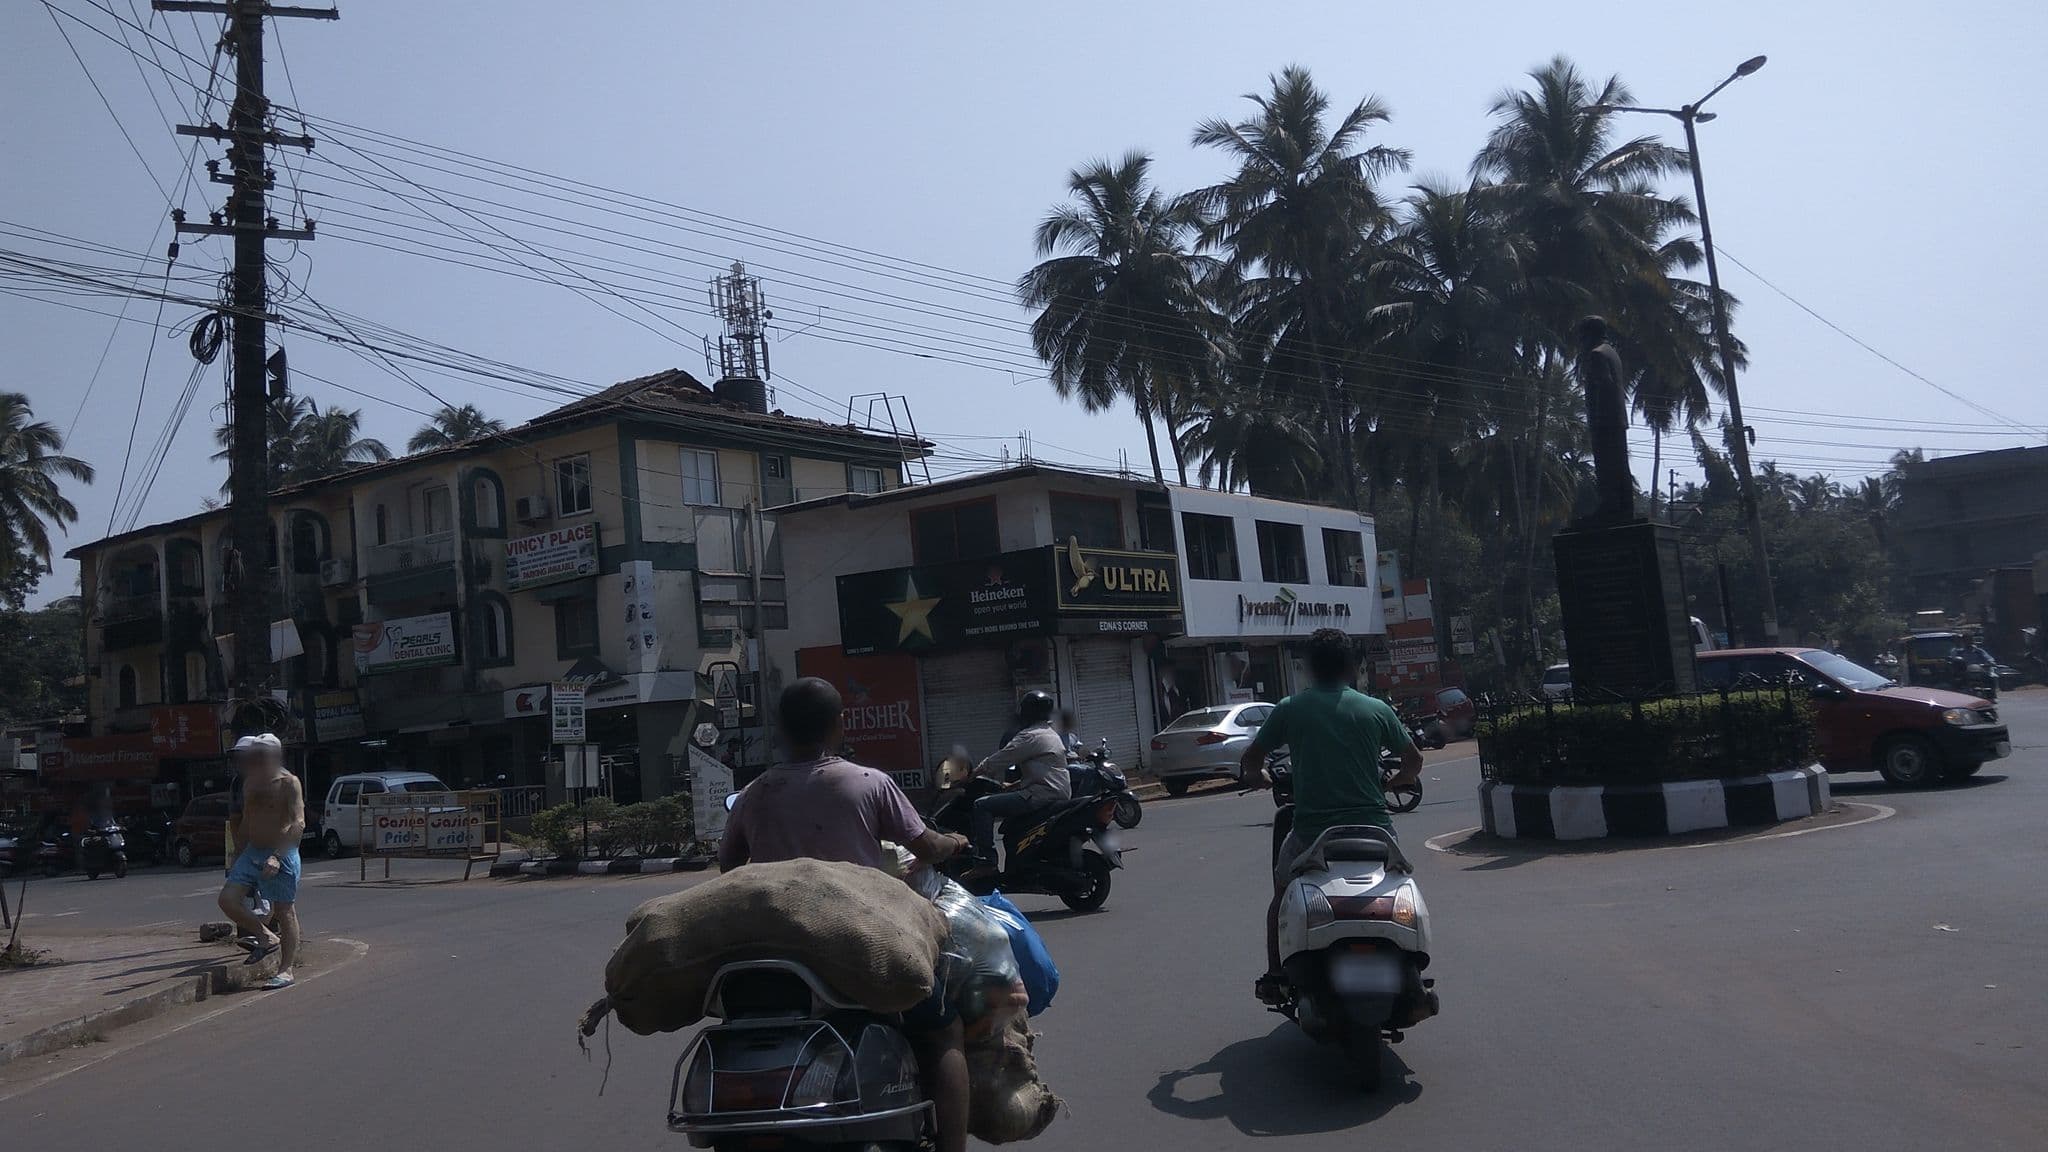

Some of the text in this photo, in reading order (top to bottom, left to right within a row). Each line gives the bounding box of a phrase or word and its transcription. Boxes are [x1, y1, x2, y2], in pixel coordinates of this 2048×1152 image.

[506, 535, 546, 556] VINCY
[549, 525, 593, 546] PLACE
[1103, 566, 1171, 592] ULTRA
[970, 587, 1025, 603] Heineken
[1007, 601, 1028, 611] world
[1297, 602, 1328, 616] SALON
[1333, 603, 1352, 617] SPA
[1099, 621, 1150, 631] EDNA'S CORNER
[394, 644, 452, 660] DENTAL CLINIC
[842, 700, 918, 733] GFISHER
[378, 816, 425, 829] Casino
[384, 831, 420, 844] Pride
